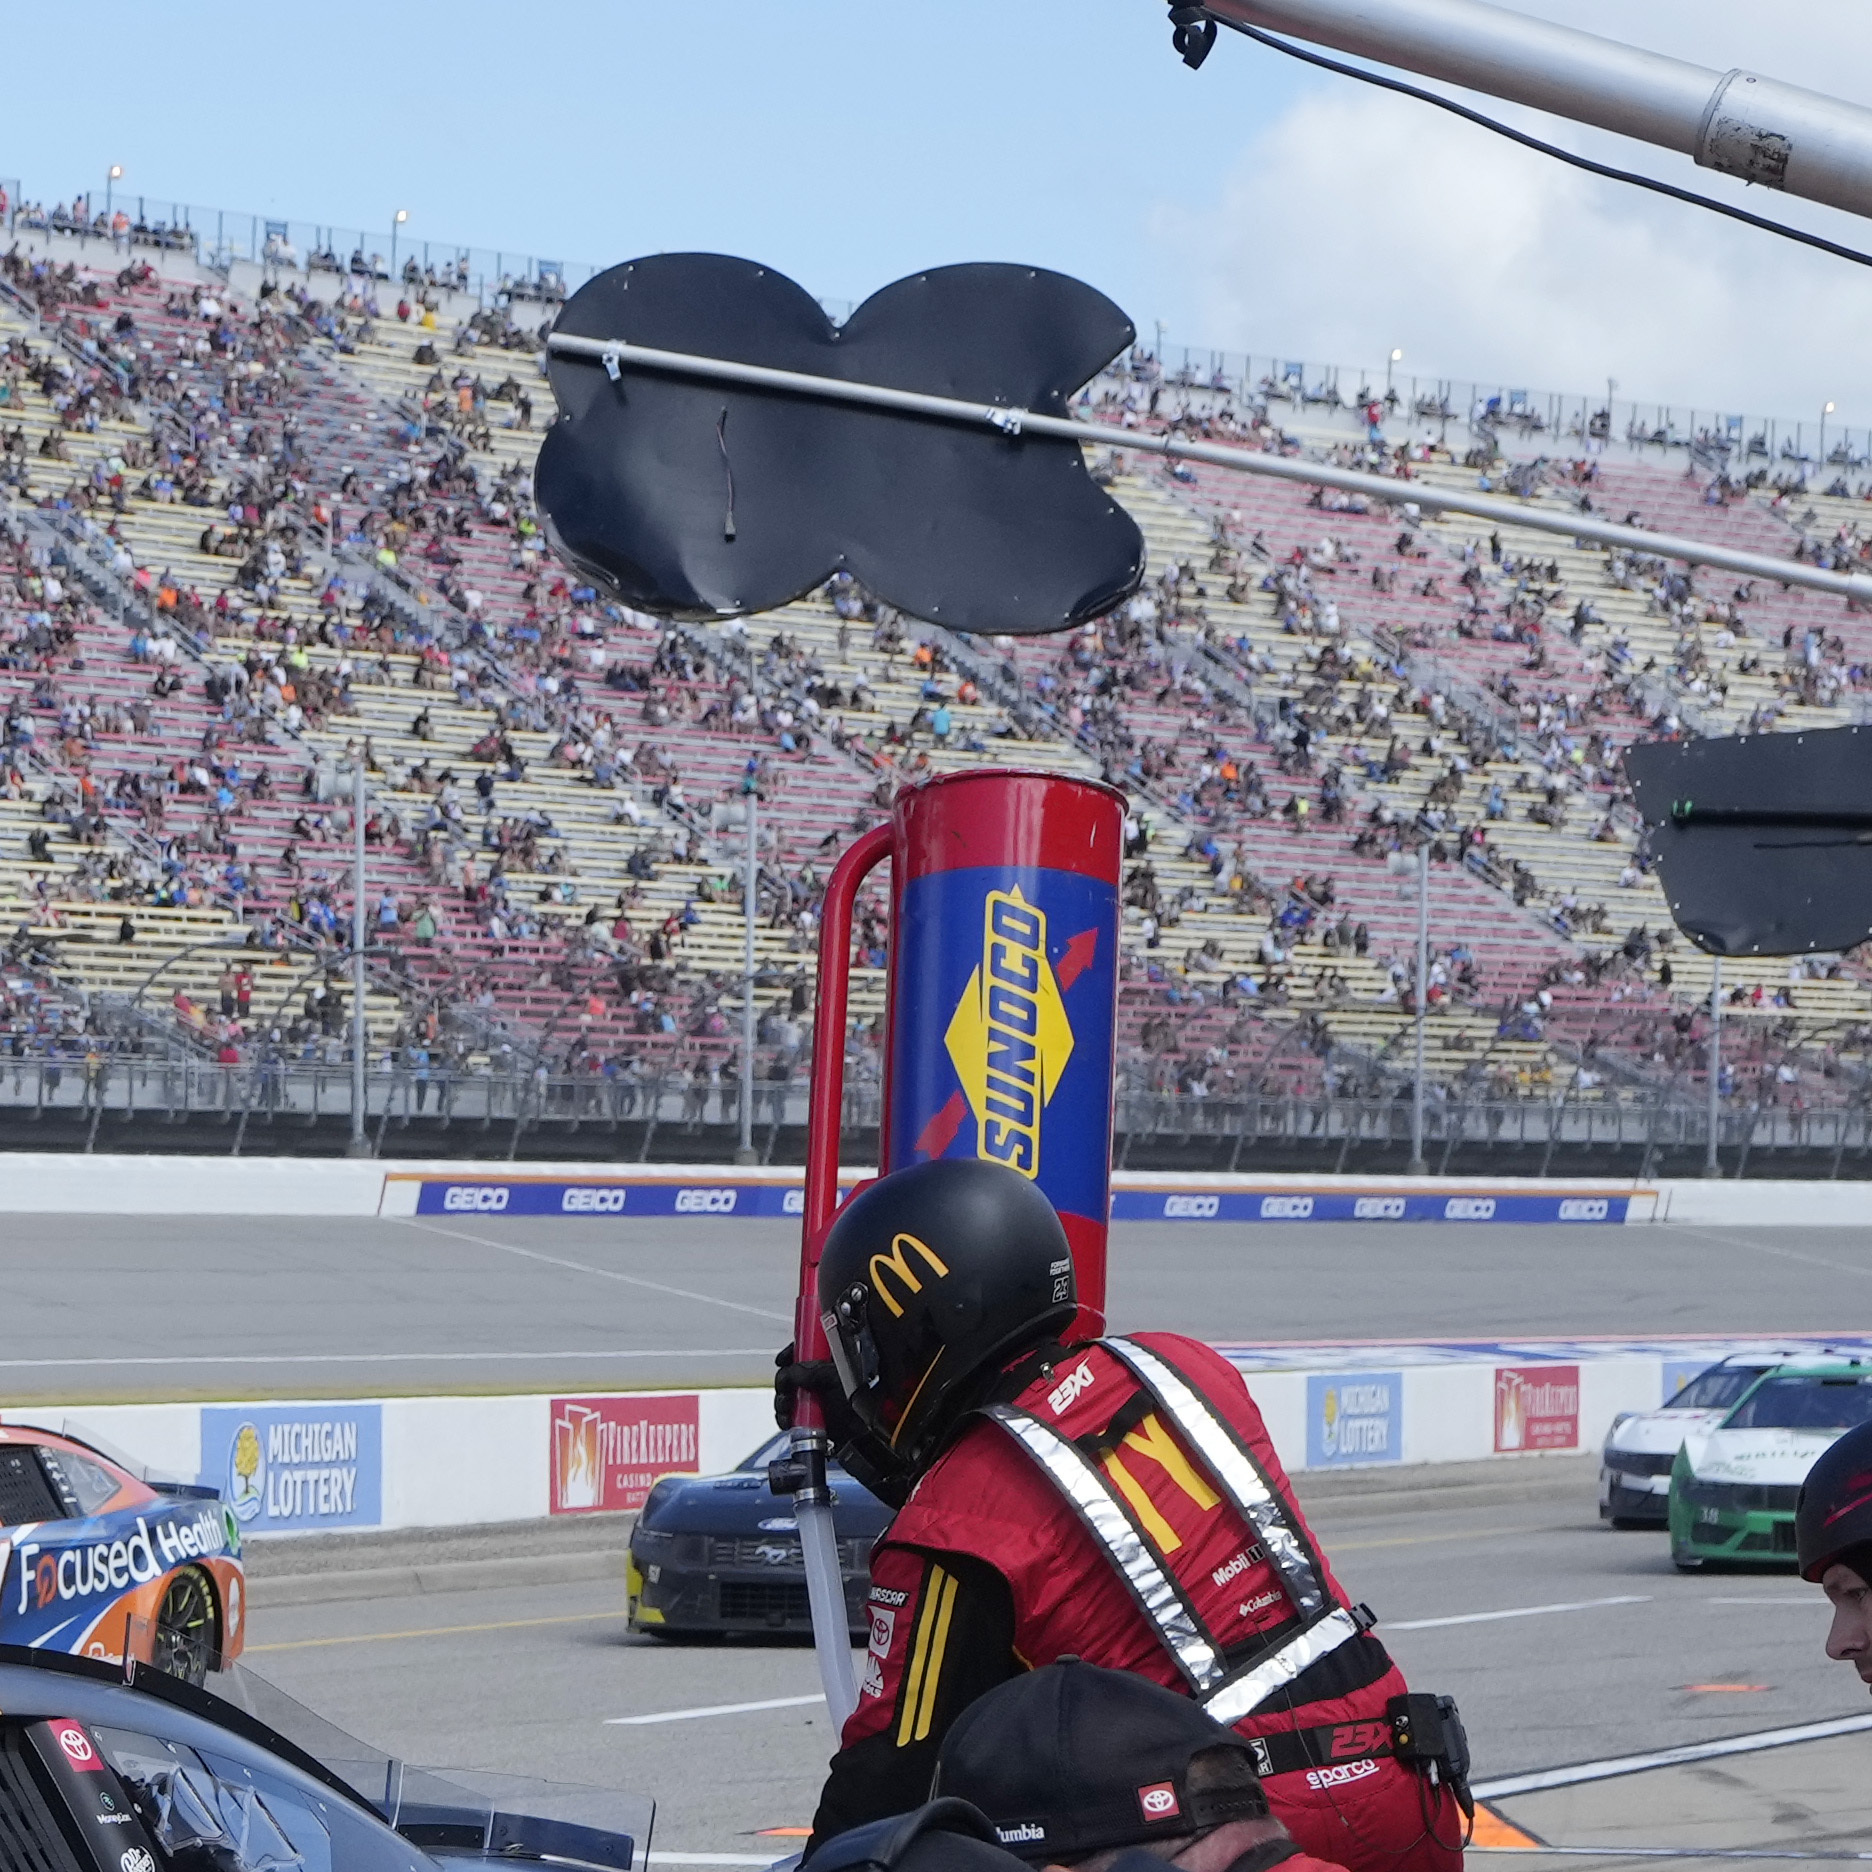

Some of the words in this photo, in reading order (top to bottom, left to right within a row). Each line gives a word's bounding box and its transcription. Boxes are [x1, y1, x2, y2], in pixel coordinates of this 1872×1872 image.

[985, 898, 1041, 1174] SUNOCO
[443, 1186, 510, 1212] GEICO
[562, 1187, 626, 1213] GEICO
[675, 1188, 737, 1213] GEICO
[1163, 1195, 1220, 1218] GEICO
[1260, 1196, 1314, 1219] GEICO
[1354, 1197, 1406, 1220] GEICO
[1445, 1197, 1496, 1221] GEICO
[1558, 1198, 1609, 1221] GEICO
[268, 1421, 357, 1466] MICHIGAN
[268, 1467, 357, 1518] LOTTERY
[17, 1517, 163, 1616] Focused
[157, 1510, 226, 1563] Health
[1212, 1554, 1252, 1588] Mobil
[1330, 1721, 1394, 1759] 23X
[1306, 1759, 1381, 1791] sparco
[996, 1822, 1046, 1846] umbia
